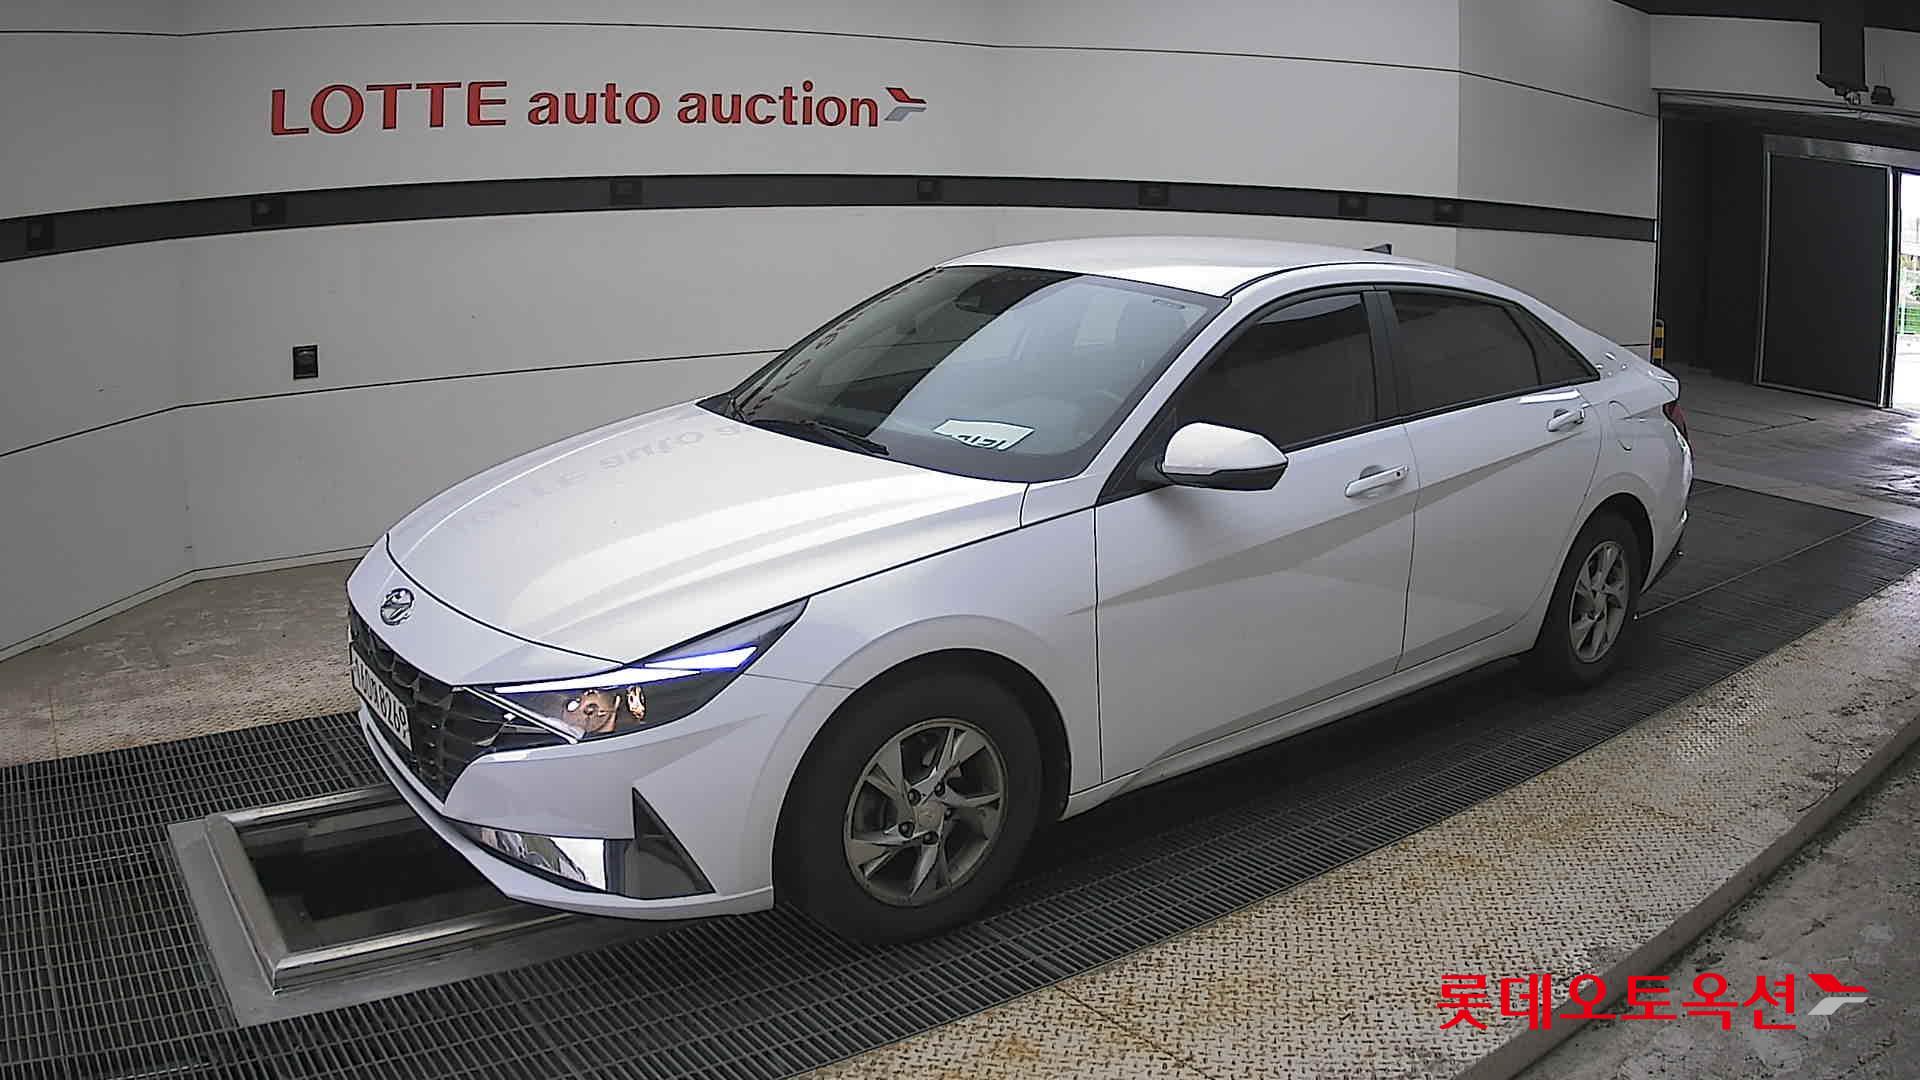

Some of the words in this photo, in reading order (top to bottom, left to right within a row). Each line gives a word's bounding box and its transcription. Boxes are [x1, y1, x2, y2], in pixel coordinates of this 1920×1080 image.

[271, 82, 507, 137] LOTTE
[529, 83, 663, 127] auto
[678, 82, 881, 127] auction
